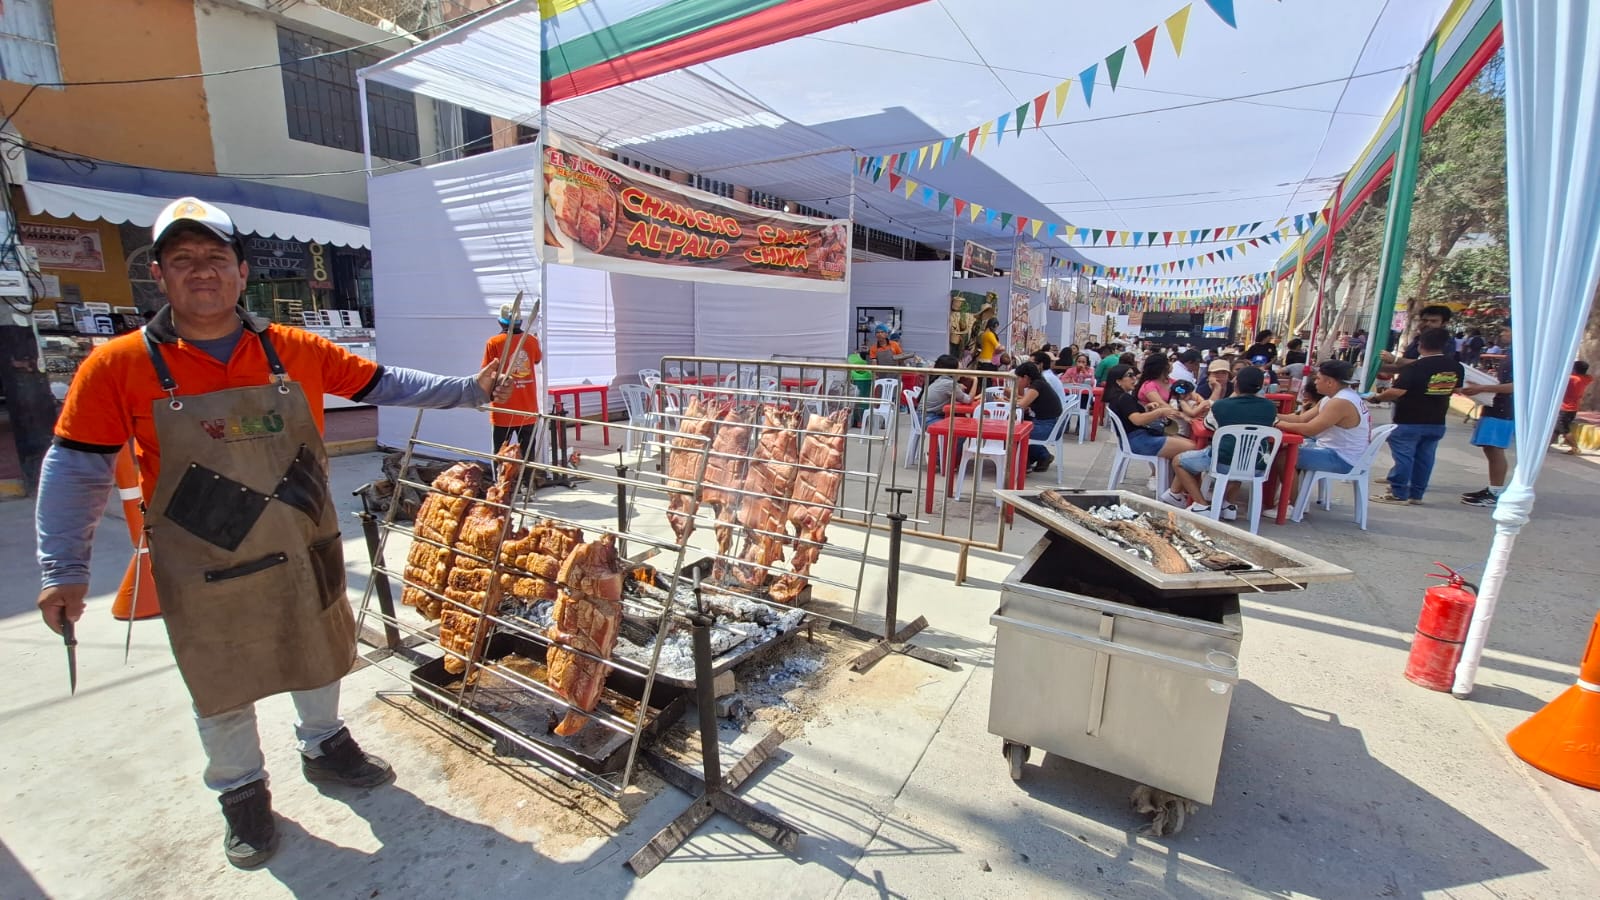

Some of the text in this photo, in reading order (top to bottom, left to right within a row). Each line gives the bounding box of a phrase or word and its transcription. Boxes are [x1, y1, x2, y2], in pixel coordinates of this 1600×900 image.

[549, 150, 567, 168] EL
[620, 186, 742, 238] CHANCHO
[626, 220, 730, 259] AL PALO
[256, 256, 301, 269] CRUZ
[309, 242, 328, 282] ORO
[743, 245, 809, 269] CHINA
